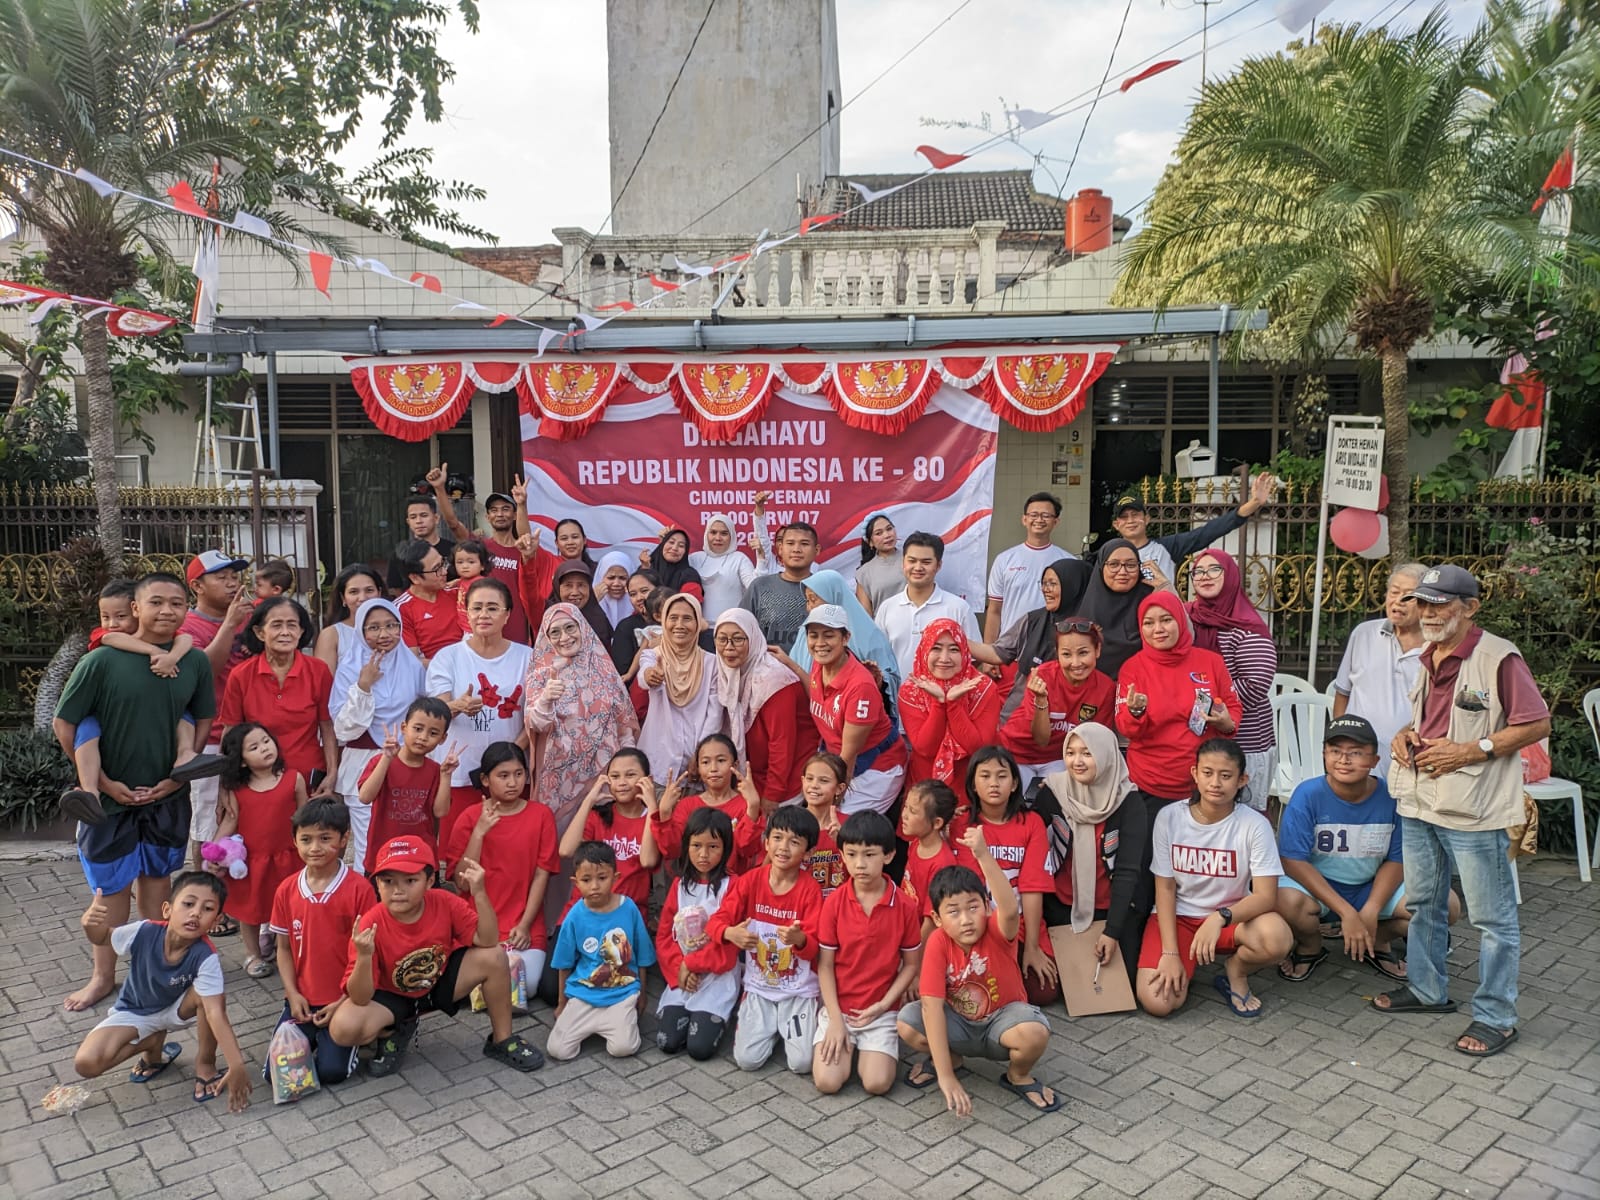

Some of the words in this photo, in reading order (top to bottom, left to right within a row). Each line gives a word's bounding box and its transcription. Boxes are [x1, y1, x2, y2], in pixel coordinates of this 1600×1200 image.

[387, 394, 450, 416] INDONESIA
[544, 394, 599, 416] INDONESIA
[683, 420, 826, 447] DGAHAYU
[1072, 430, 1079, 441] 9
[1338, 438, 1358, 448] DOKTER
[578, 458, 702, 485] REPUBLIK
[709, 457, 844, 483] INDONESIA
[853, 457, 883, 482] KE
[913, 457, 945, 482] 80
[689, 490, 757, 505] CIMONE
[764, 489, 831, 504] PERMAI
[799, 510, 820, 525] 07
[856, 699, 869, 719] 5
[1317, 829, 1349, 853] 81
[1174, 846, 1236, 876] MARVEL
